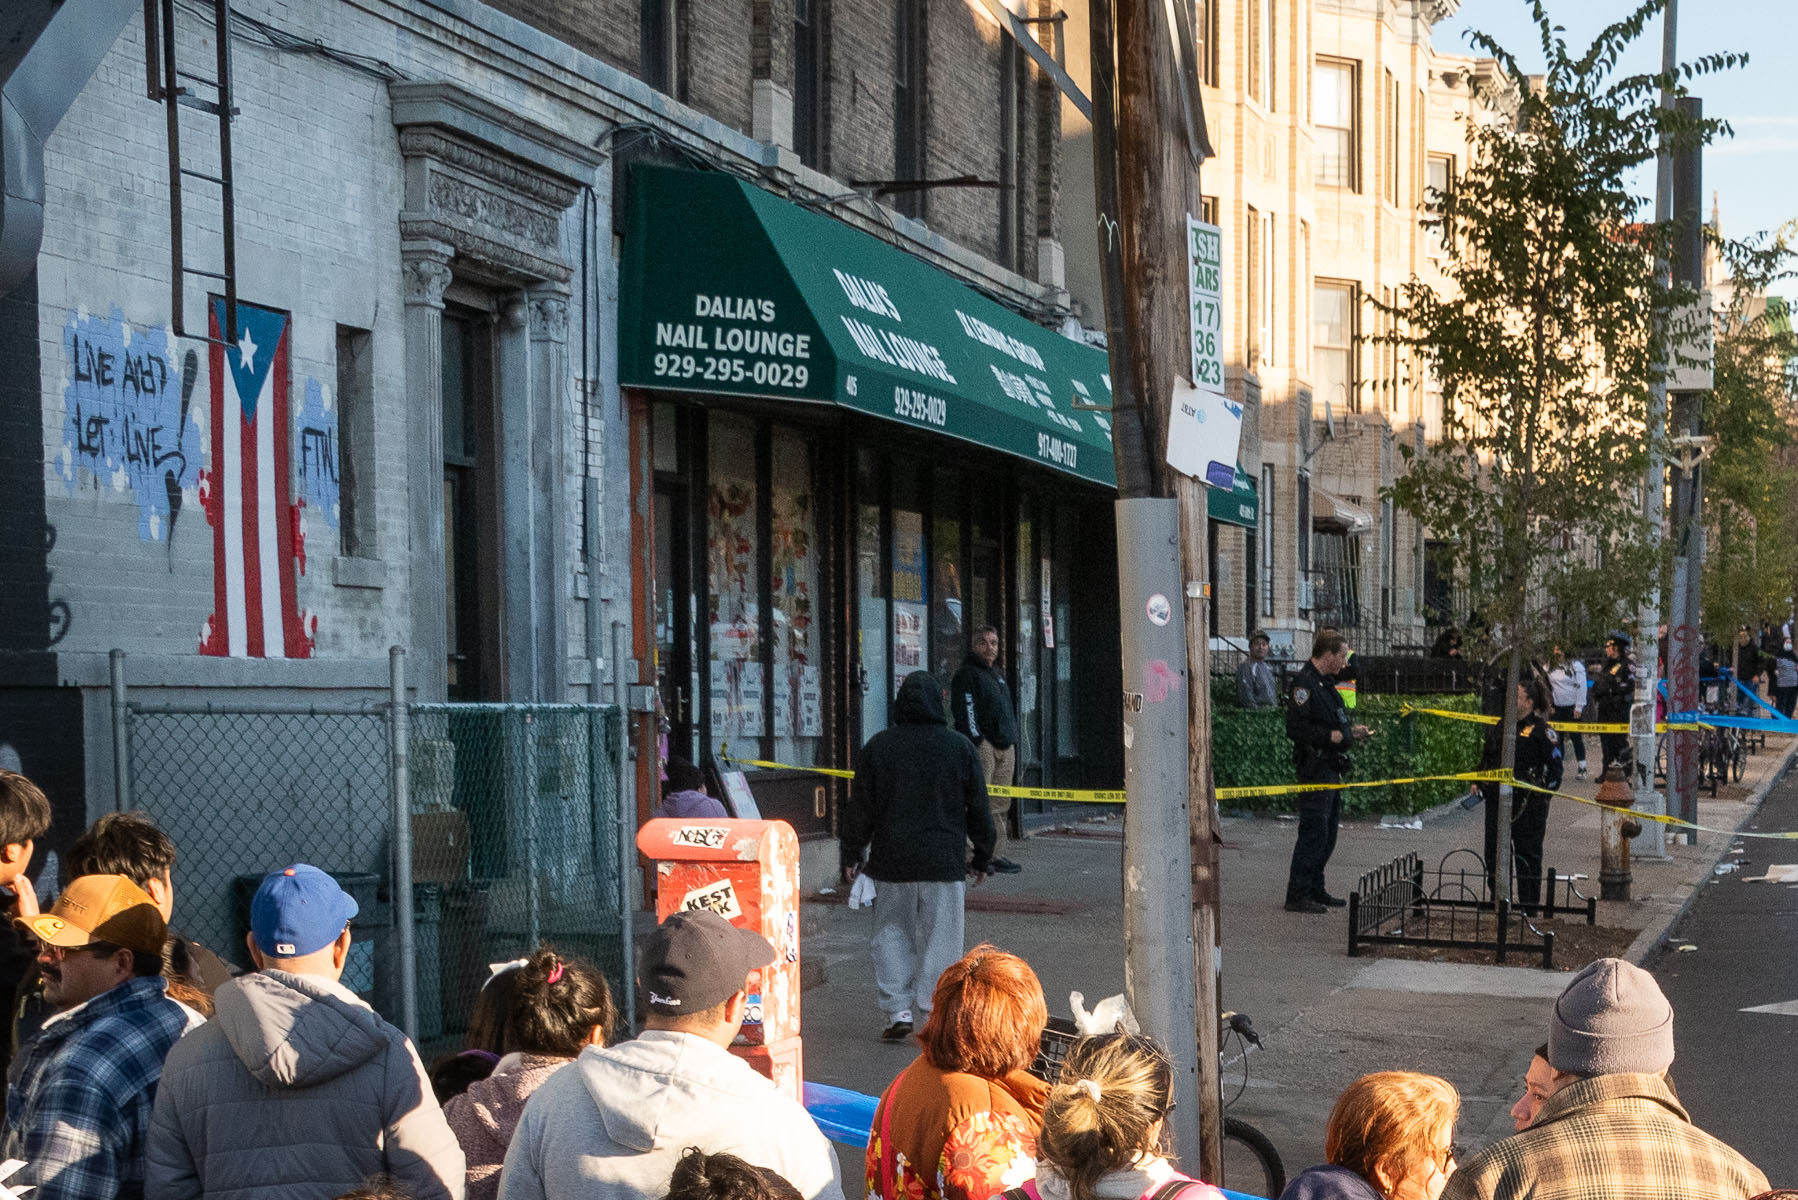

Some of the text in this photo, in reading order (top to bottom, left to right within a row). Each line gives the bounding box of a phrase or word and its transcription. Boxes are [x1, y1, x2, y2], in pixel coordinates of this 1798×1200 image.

[695, 294, 777, 323] DALIA'S
[832, 268, 902, 322] DALIA'S
[656, 322, 812, 360] NAIL LOUNGE
[840, 314, 898, 366] NAIL
[878, 328, 958, 386] LOUNGE
[654, 352, 810, 389] 929-295-0029
[894, 385, 948, 427] 929-295-0029
